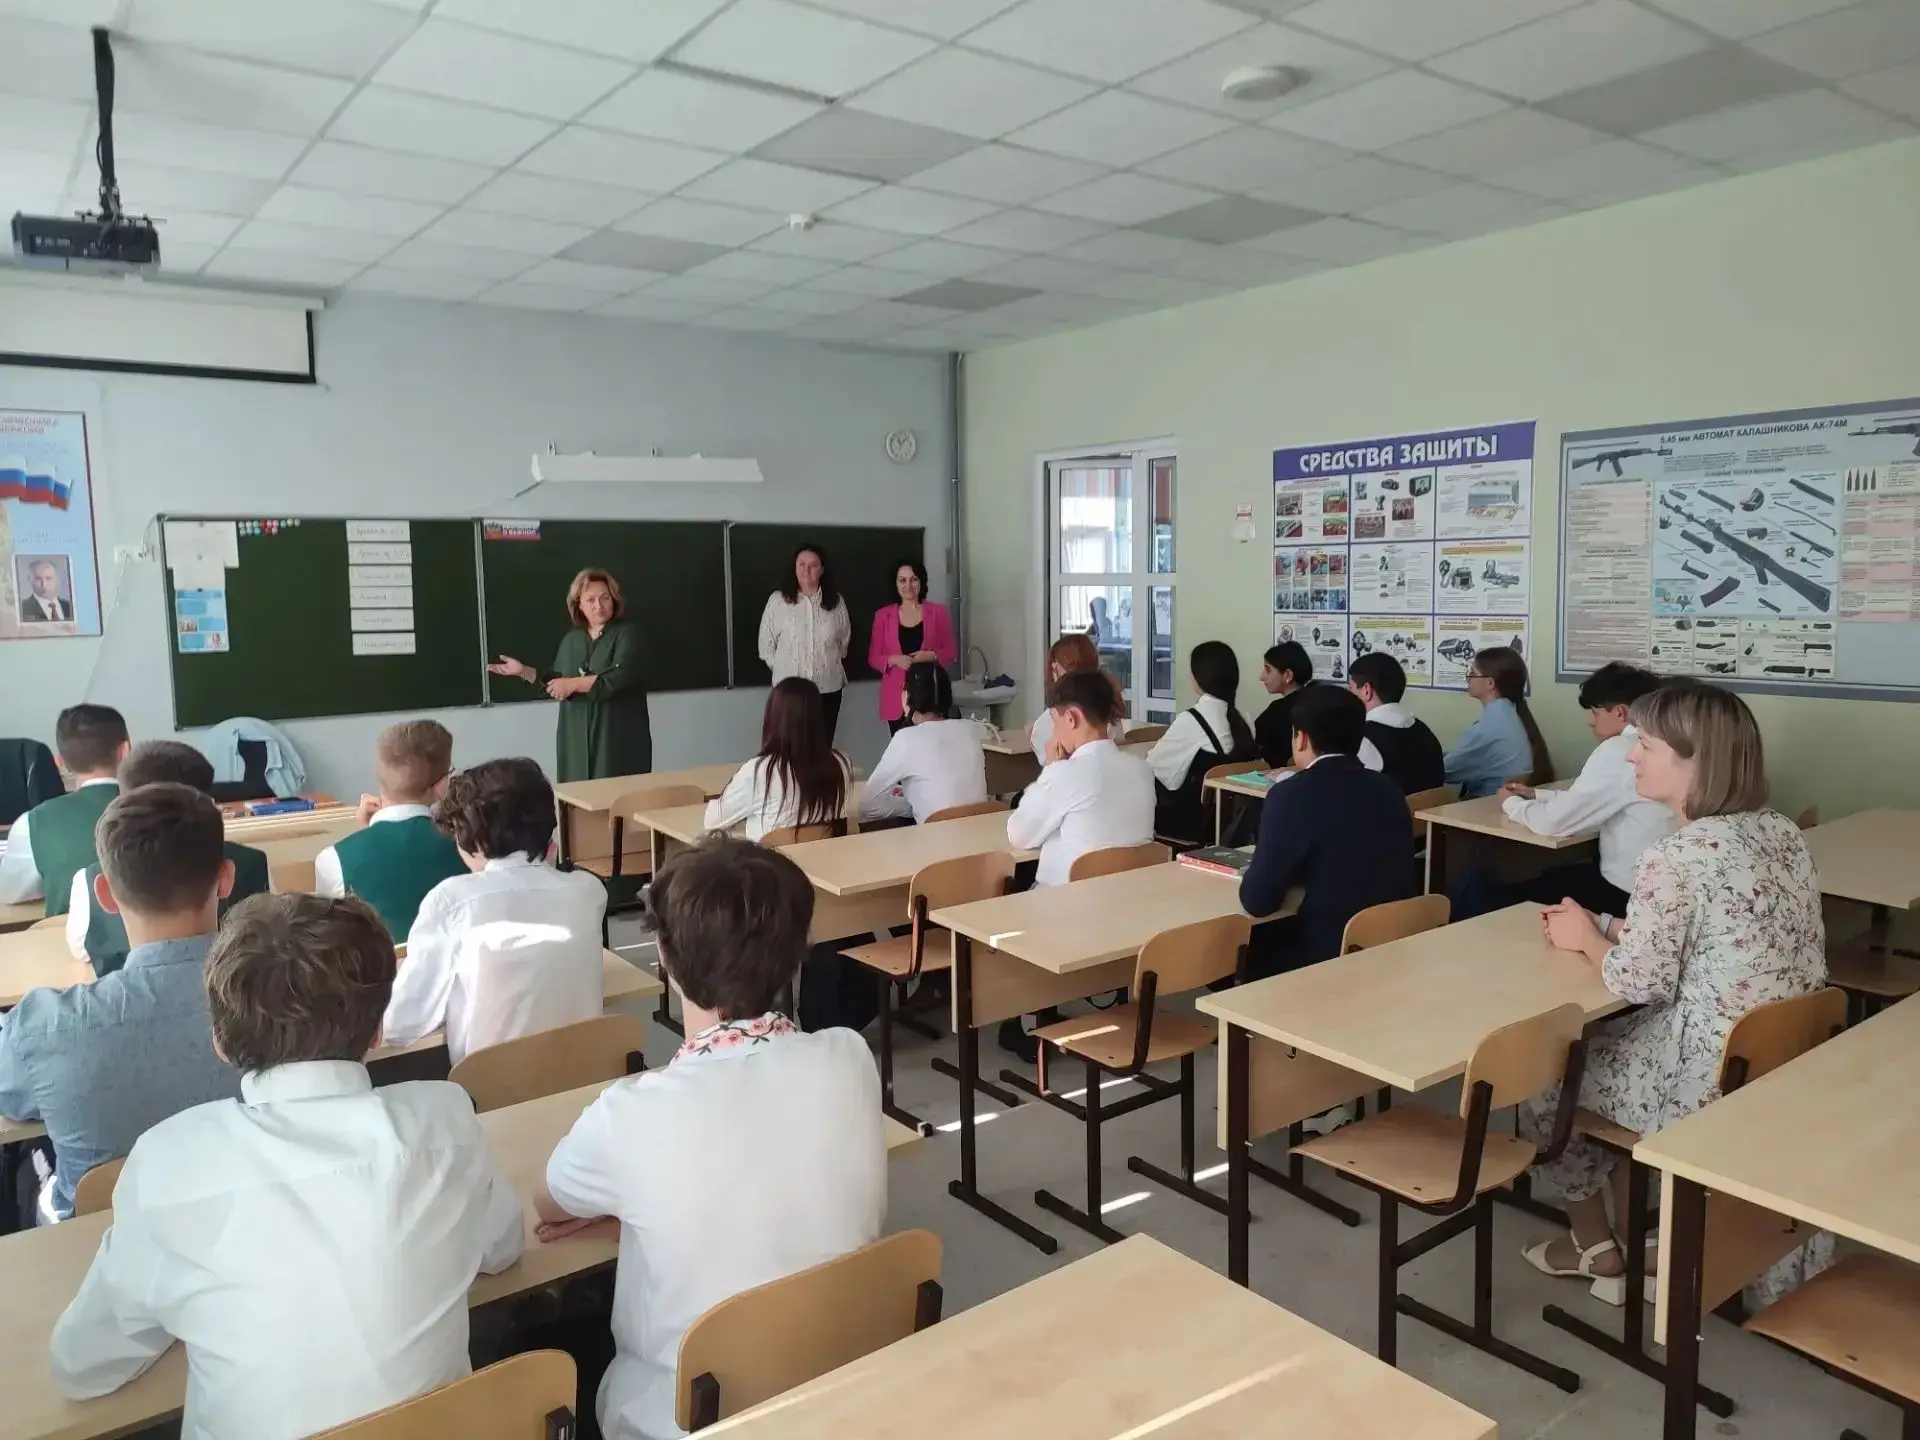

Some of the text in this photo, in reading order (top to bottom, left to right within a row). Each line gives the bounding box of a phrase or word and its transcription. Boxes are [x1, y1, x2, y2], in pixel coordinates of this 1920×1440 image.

[1692, 429, 1735, 441] АВТОМАТ
[1736, 423, 1810, 437] КАЛАШНИКОВА
[1811, 419, 1848, 430] АК-74М
[1299, 434, 1498, 473] СРЕДСТВА ЗАЩИТЫ
